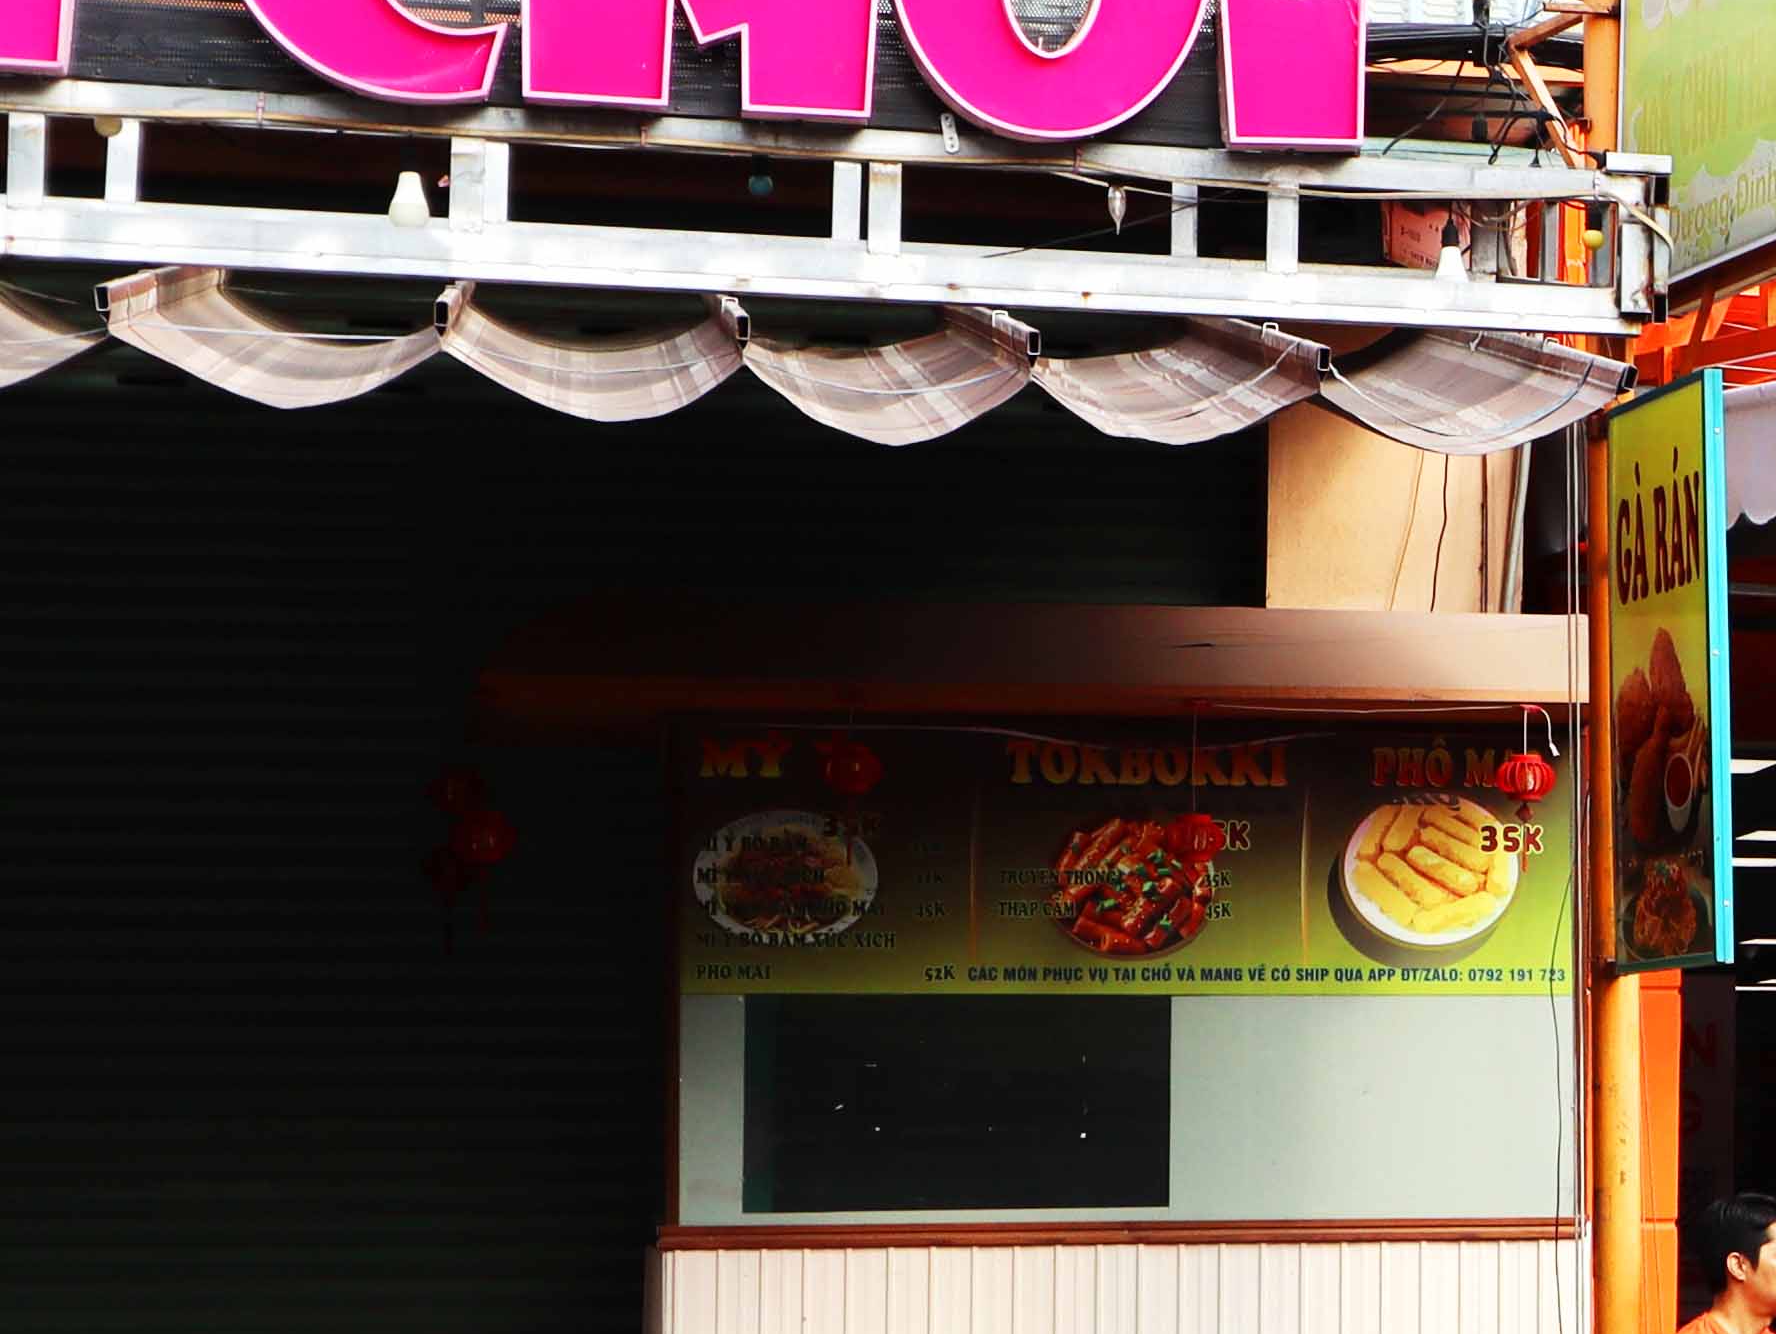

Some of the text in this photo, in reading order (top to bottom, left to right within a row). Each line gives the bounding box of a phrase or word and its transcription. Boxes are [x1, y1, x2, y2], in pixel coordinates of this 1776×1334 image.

[1616, 446, 1701, 606] GÀ RÁN
[1481, 824, 1544, 853] 35K
[967, 963, 998, 982] CÁC
[1002, 963, 1038, 982] MÓN
[1042, 966, 1077, 986] PHỤC
[1083, 966, 1108, 986] VỤ
[1200, 966, 1243, 982] MANG
[1296, 967, 1329, 983] SHIP
[1334, 967, 1364, 984] QUA
[1369, 967, 1396, 982] APP
[1468, 967, 1503, 982] 0792
[1510, 967, 1532, 982] 191
[1538, 967, 1566, 983] 723
